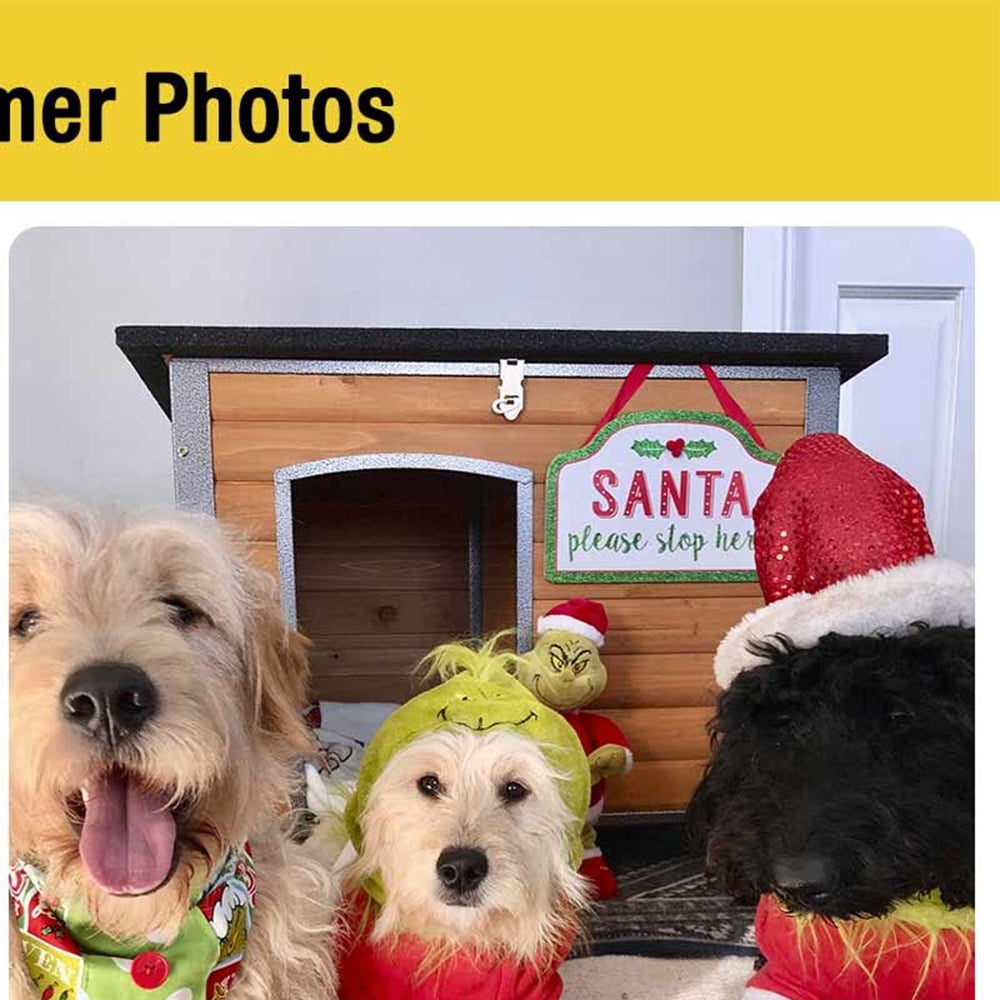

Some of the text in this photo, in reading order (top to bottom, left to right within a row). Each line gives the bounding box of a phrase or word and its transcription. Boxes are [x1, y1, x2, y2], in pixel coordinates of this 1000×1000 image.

[591, 469, 753, 520] SANTA
[567, 523, 755, 563] please stop her
